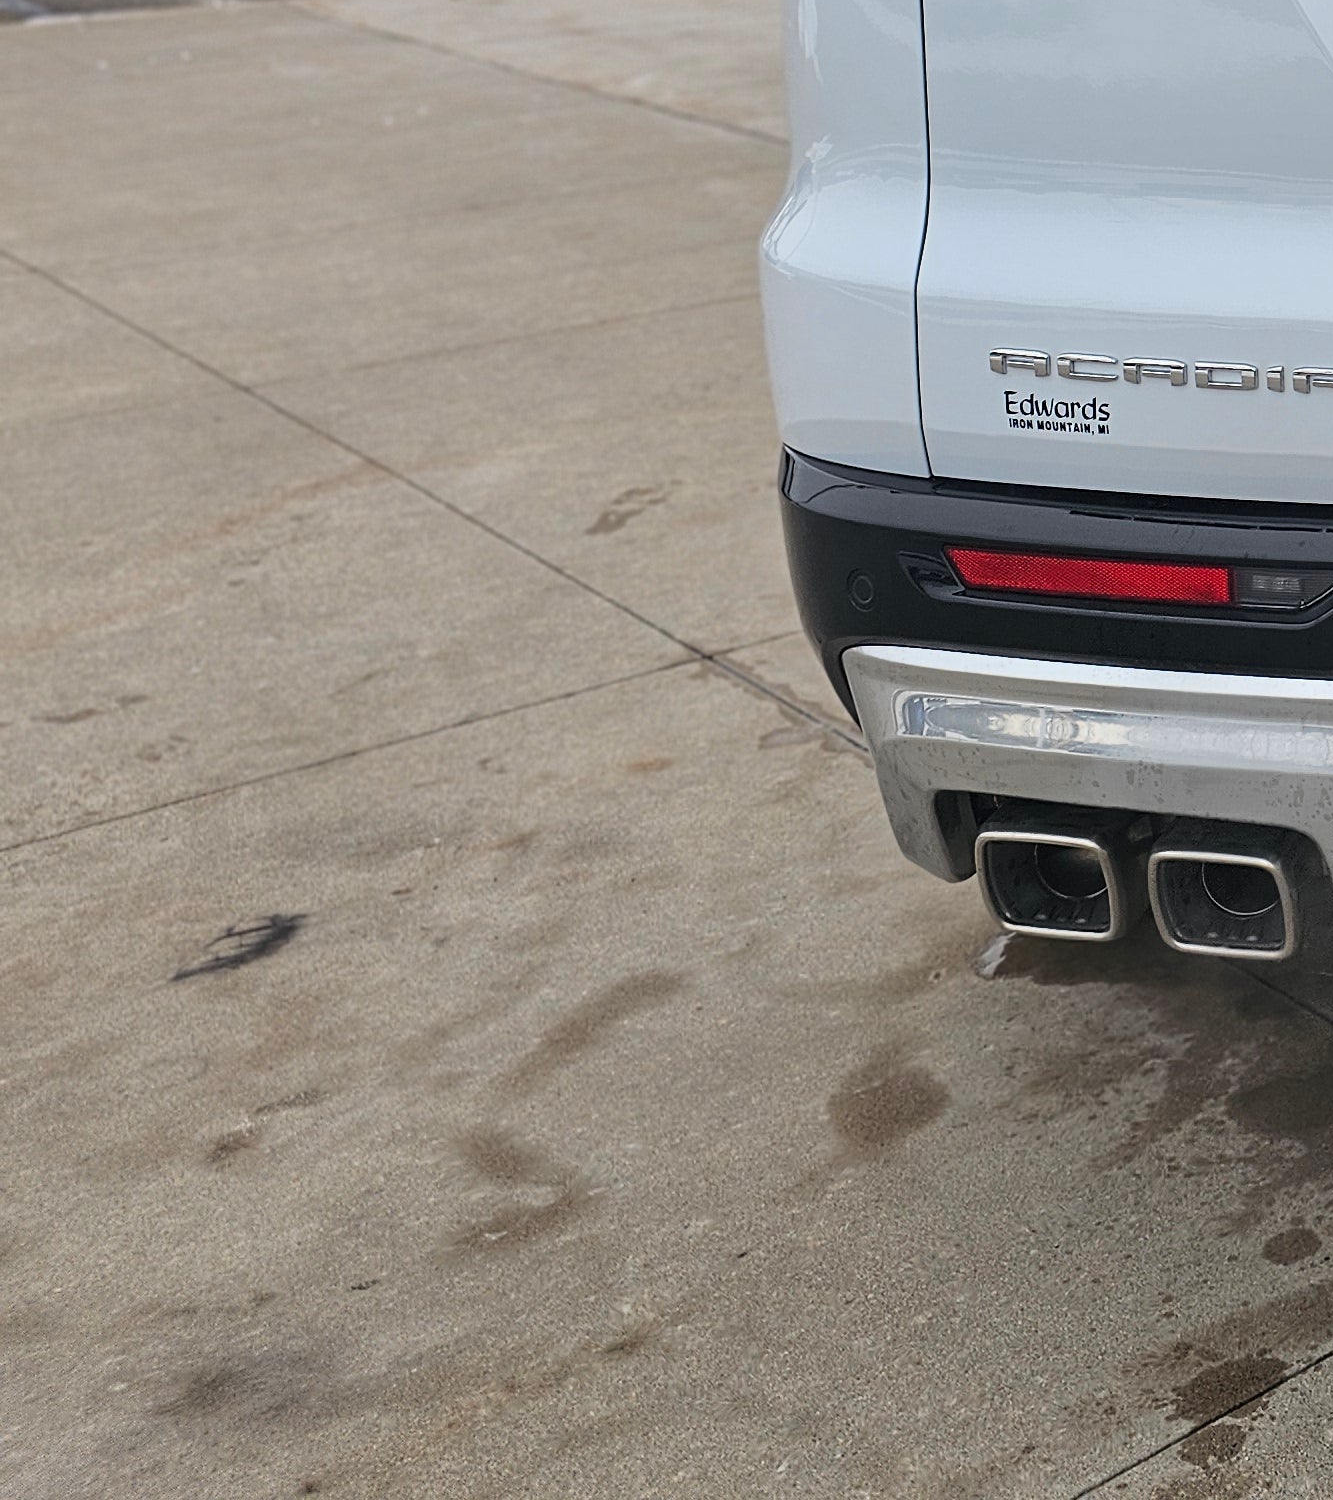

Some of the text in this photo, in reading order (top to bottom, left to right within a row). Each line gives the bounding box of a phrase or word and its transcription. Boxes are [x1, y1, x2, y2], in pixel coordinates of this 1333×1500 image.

[1004, 390, 1110, 421] Edwards
[1009, 418, 1110, 434] IRON MOUNTAIN, MI
